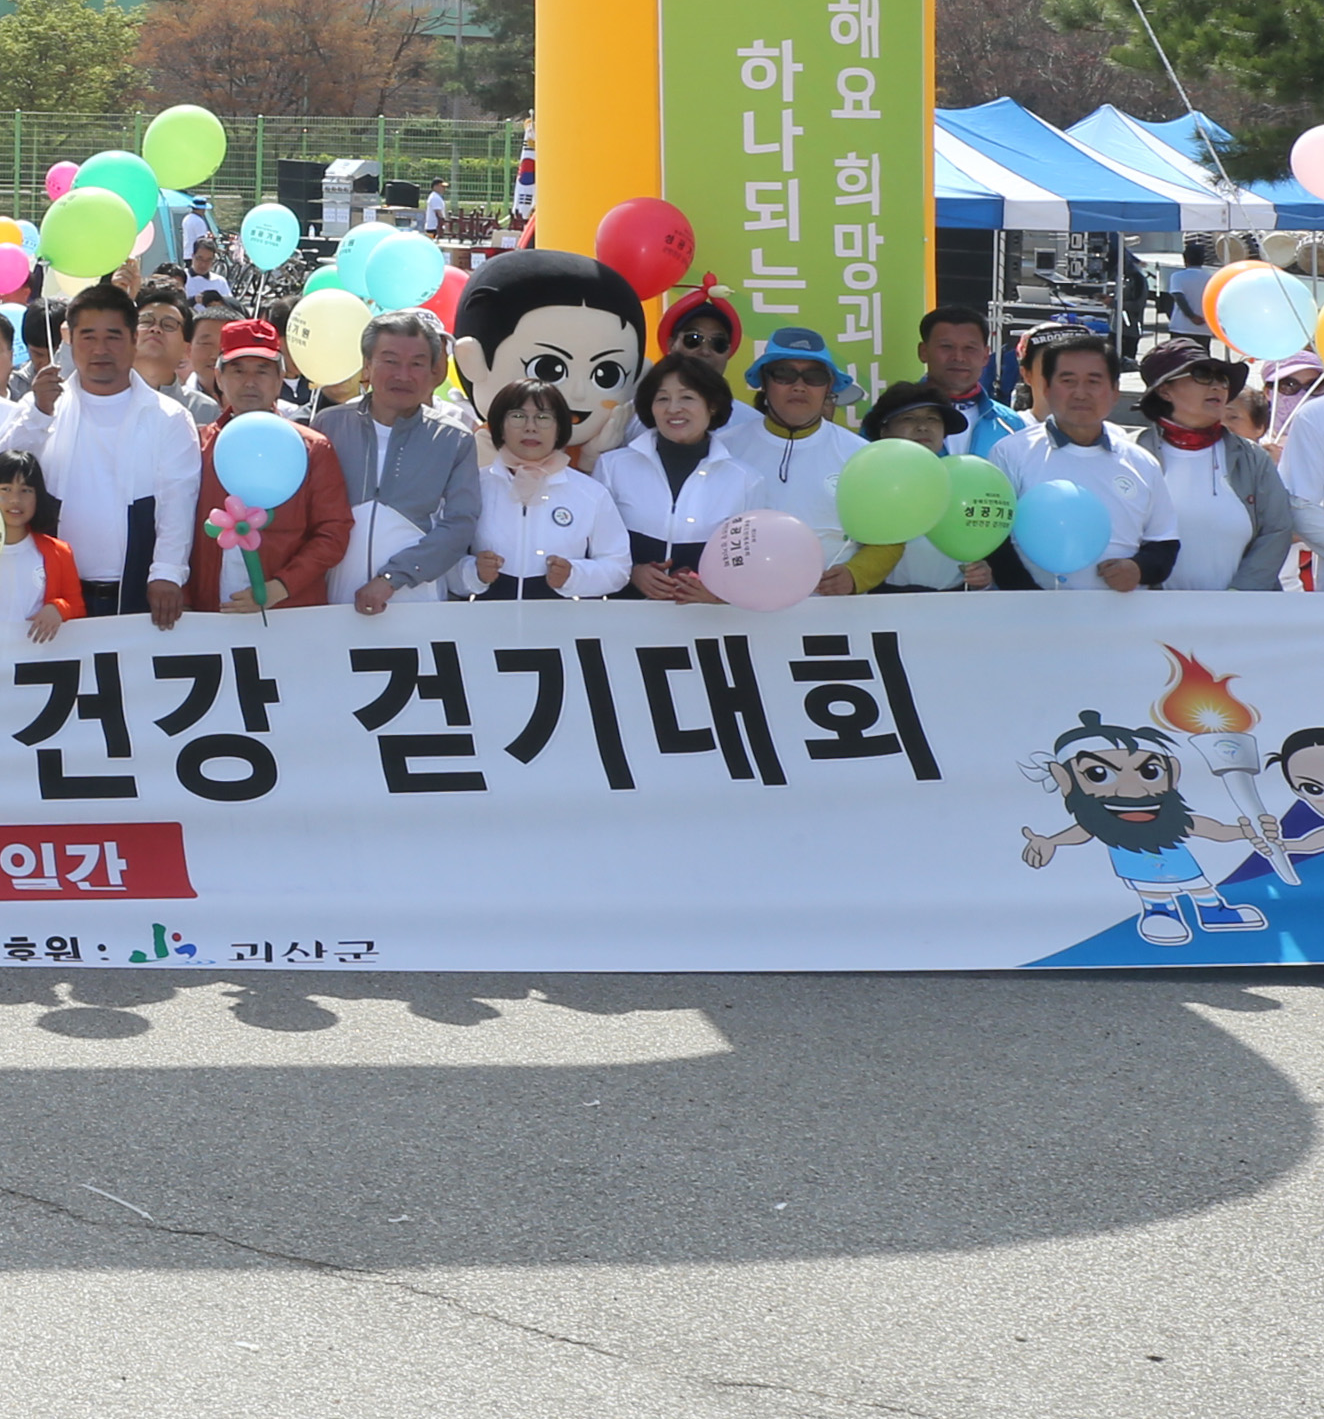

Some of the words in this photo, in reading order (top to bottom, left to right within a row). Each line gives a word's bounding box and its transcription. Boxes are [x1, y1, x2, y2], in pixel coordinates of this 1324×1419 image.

[736, 38, 806, 314] 하나되는
[964, 506, 1013, 521] 성공기원
[349, 630, 943, 796] 걷기대회
[3, 936, 83, 963] 후원
[227, 938, 380, 964] 괴산군
